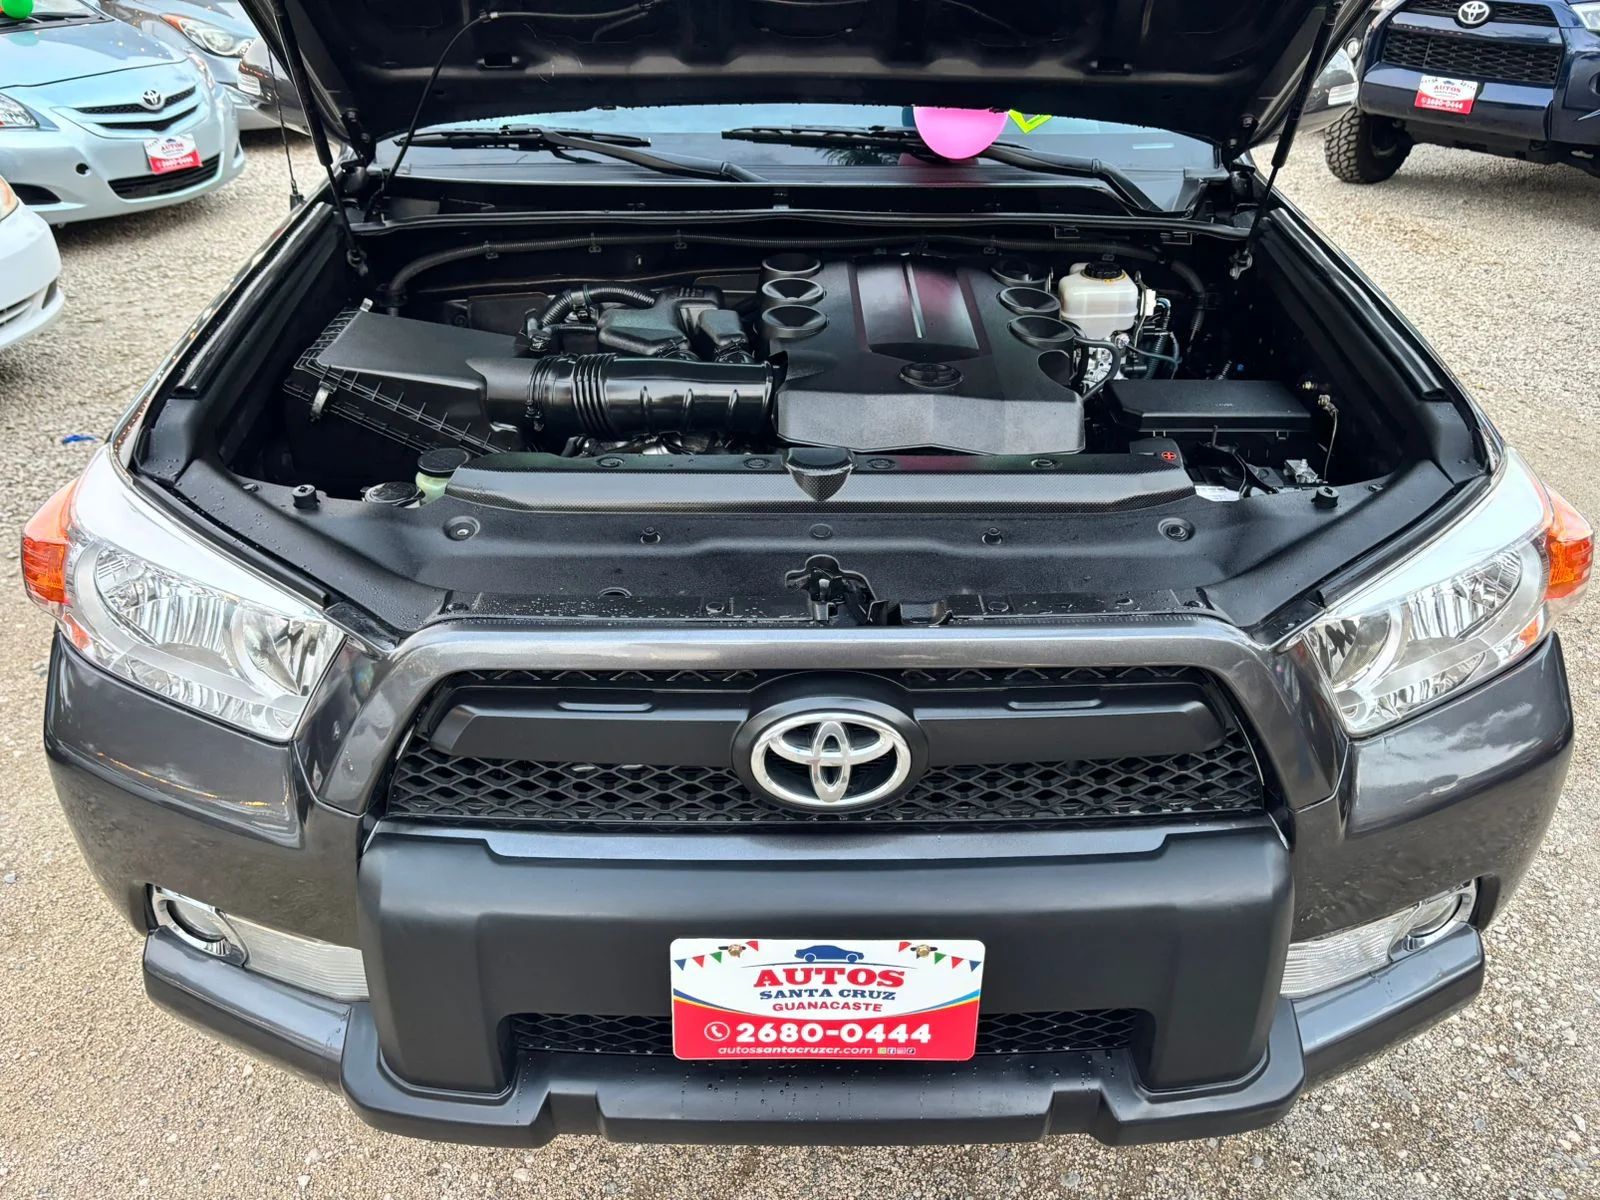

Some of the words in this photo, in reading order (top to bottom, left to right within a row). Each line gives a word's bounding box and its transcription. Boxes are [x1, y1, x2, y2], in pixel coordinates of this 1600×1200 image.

[754, 967, 905, 988] AUTOS
[760, 988, 832, 1000] SANTA
[838, 989, 897, 1001] CRUZ
[772, 1001, 883, 1013] GUANACASTE
[736, 1022, 931, 1044] 2680-0444
[717, 1046, 873, 1055] autossantacruzcr.com
